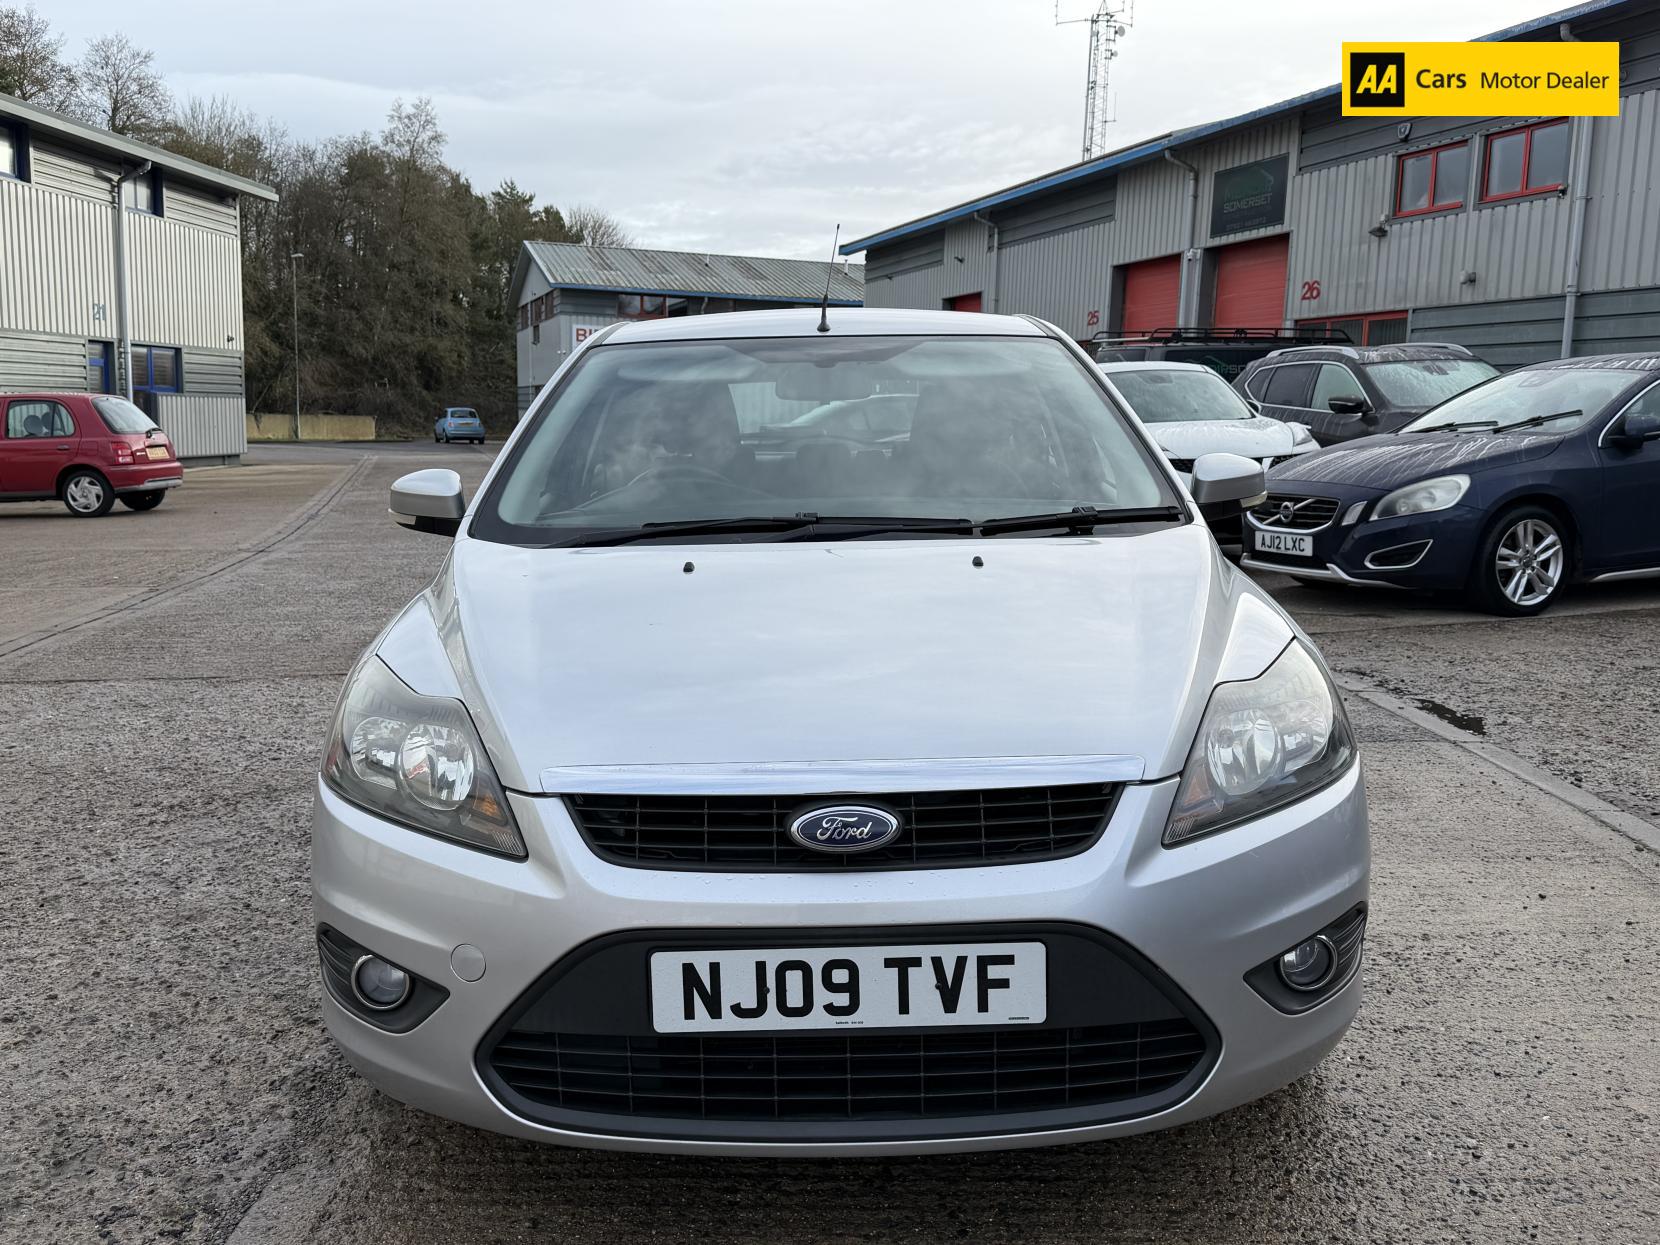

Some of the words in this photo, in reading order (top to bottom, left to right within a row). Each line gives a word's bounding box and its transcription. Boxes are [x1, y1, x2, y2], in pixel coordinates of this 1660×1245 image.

[1223, 193, 1272, 212] SOMERSET
[1301, 280, 1321, 300] 26
[93, 304, 106, 320] 21
[1087, 310, 1099, 326] 25
[1261, 534, 1281, 549] AJ12
[1284, 536, 1305, 552] LXC
[816, 816, 873, 840] Ford
[681, 958, 860, 1020] NJ09
[883, 954, 1016, 1016] TVF
